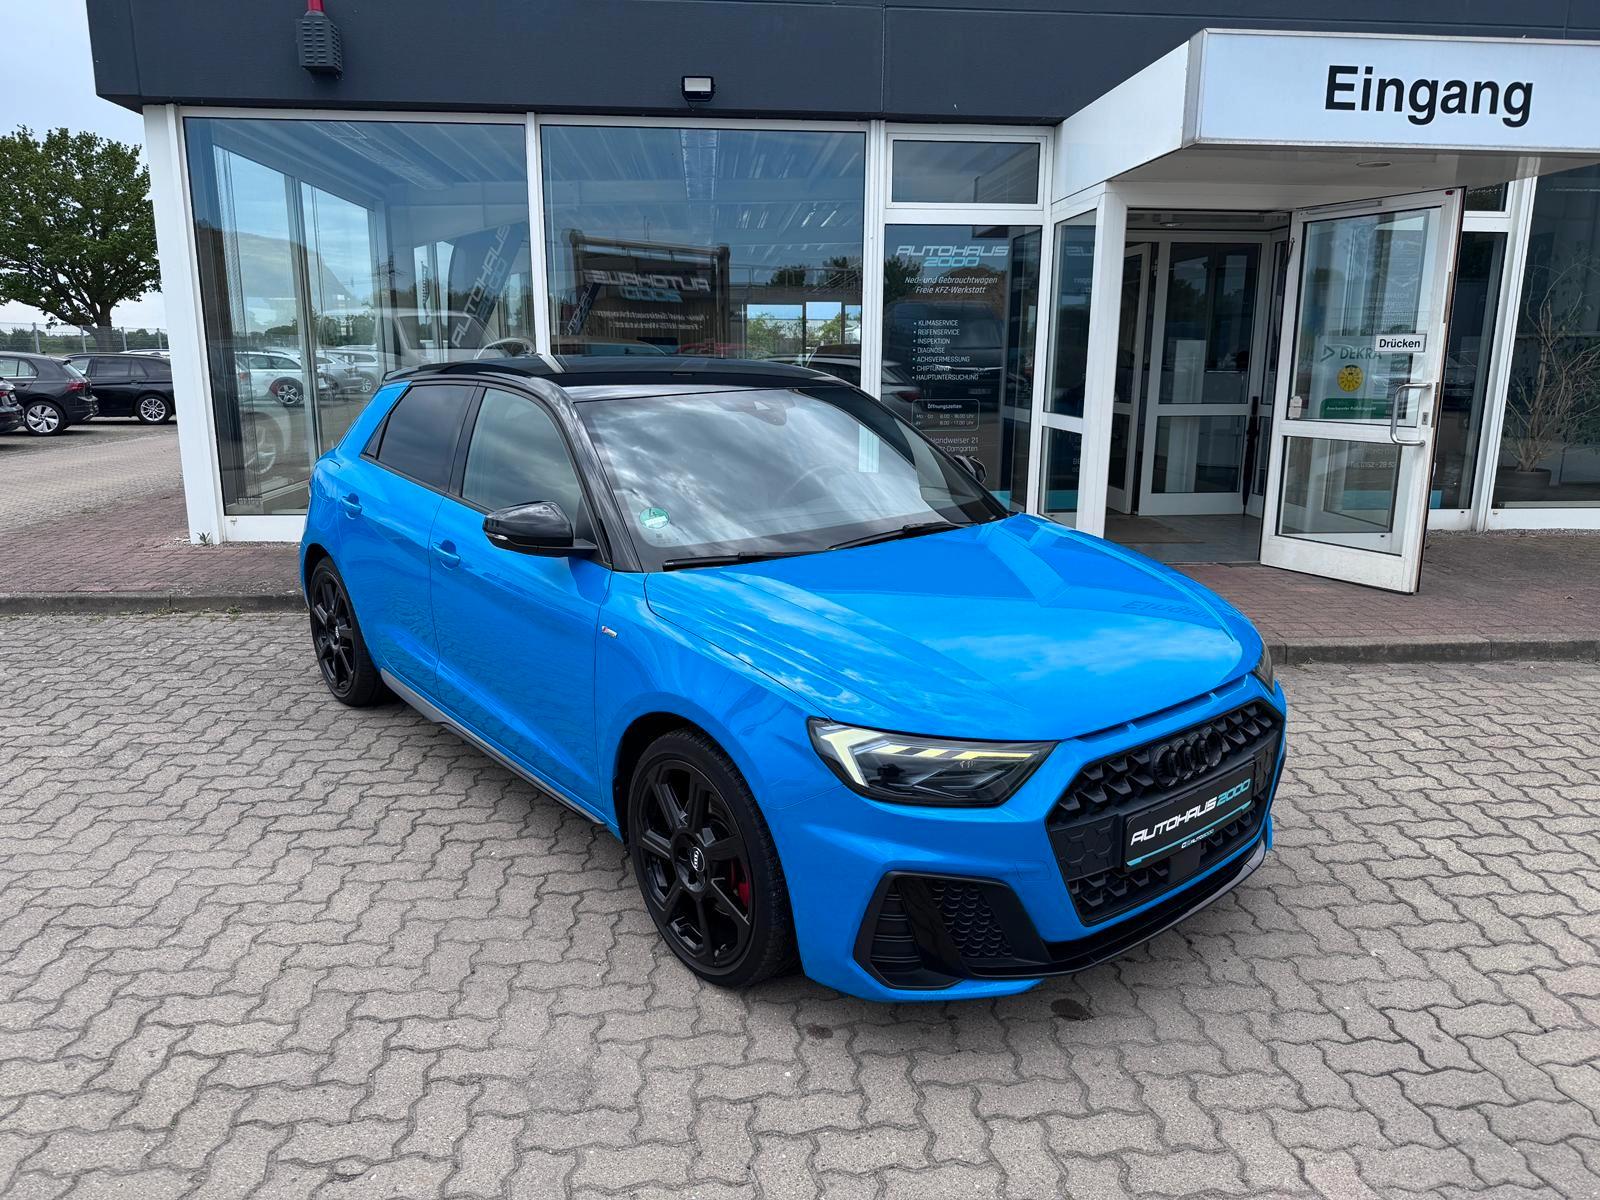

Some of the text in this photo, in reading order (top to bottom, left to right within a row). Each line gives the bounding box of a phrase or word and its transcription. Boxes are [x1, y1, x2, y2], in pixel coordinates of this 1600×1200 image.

[1325, 65, 1533, 128] Eingang
[895, 245, 1010, 257] AUTOHAUS
[923, 257, 981, 267] 2000
[923, 276, 937, 284] und
[938, 276, 998, 285] Gebrauchtwagen
[915, 286, 986, 294] Freie KFZ-Werkstatt
[918, 319, 959, 327] KLIMASERVICE
[917, 328, 960, 336] REIFENSERVICE
[917, 337, 951, 345] INSPEKTION
[1379, 338, 1421, 349] Drücken
[917, 346, 945, 354] DIAGNOSE
[1339, 347, 1382, 360] DEKRA
[916, 355, 970, 363] ACHSVERMESSUNG
[916, 364, 950, 372] CHIPTUNING
[915, 373, 979, 381] HAUPTUNTERSUCHUNG
